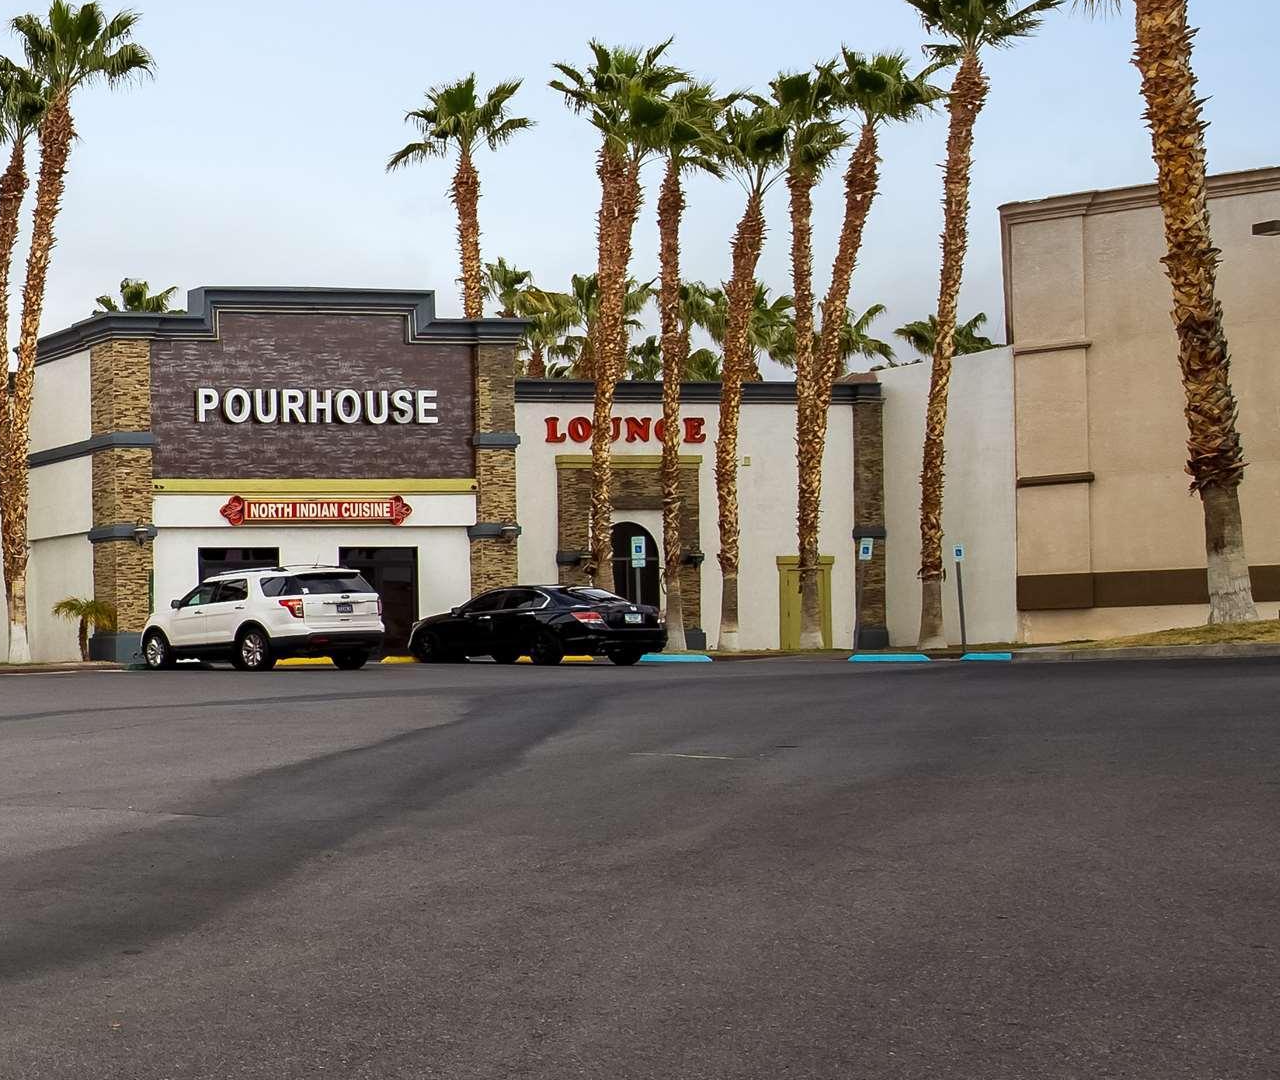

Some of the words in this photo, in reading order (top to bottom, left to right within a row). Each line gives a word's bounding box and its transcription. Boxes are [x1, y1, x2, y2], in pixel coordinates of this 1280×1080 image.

[196, 387, 439, 424] POURHOUSE
[250, 503, 293, 518] NORTH
[296, 503, 338, 518] INDIAN
[341, 503, 391, 518] CUISINE
